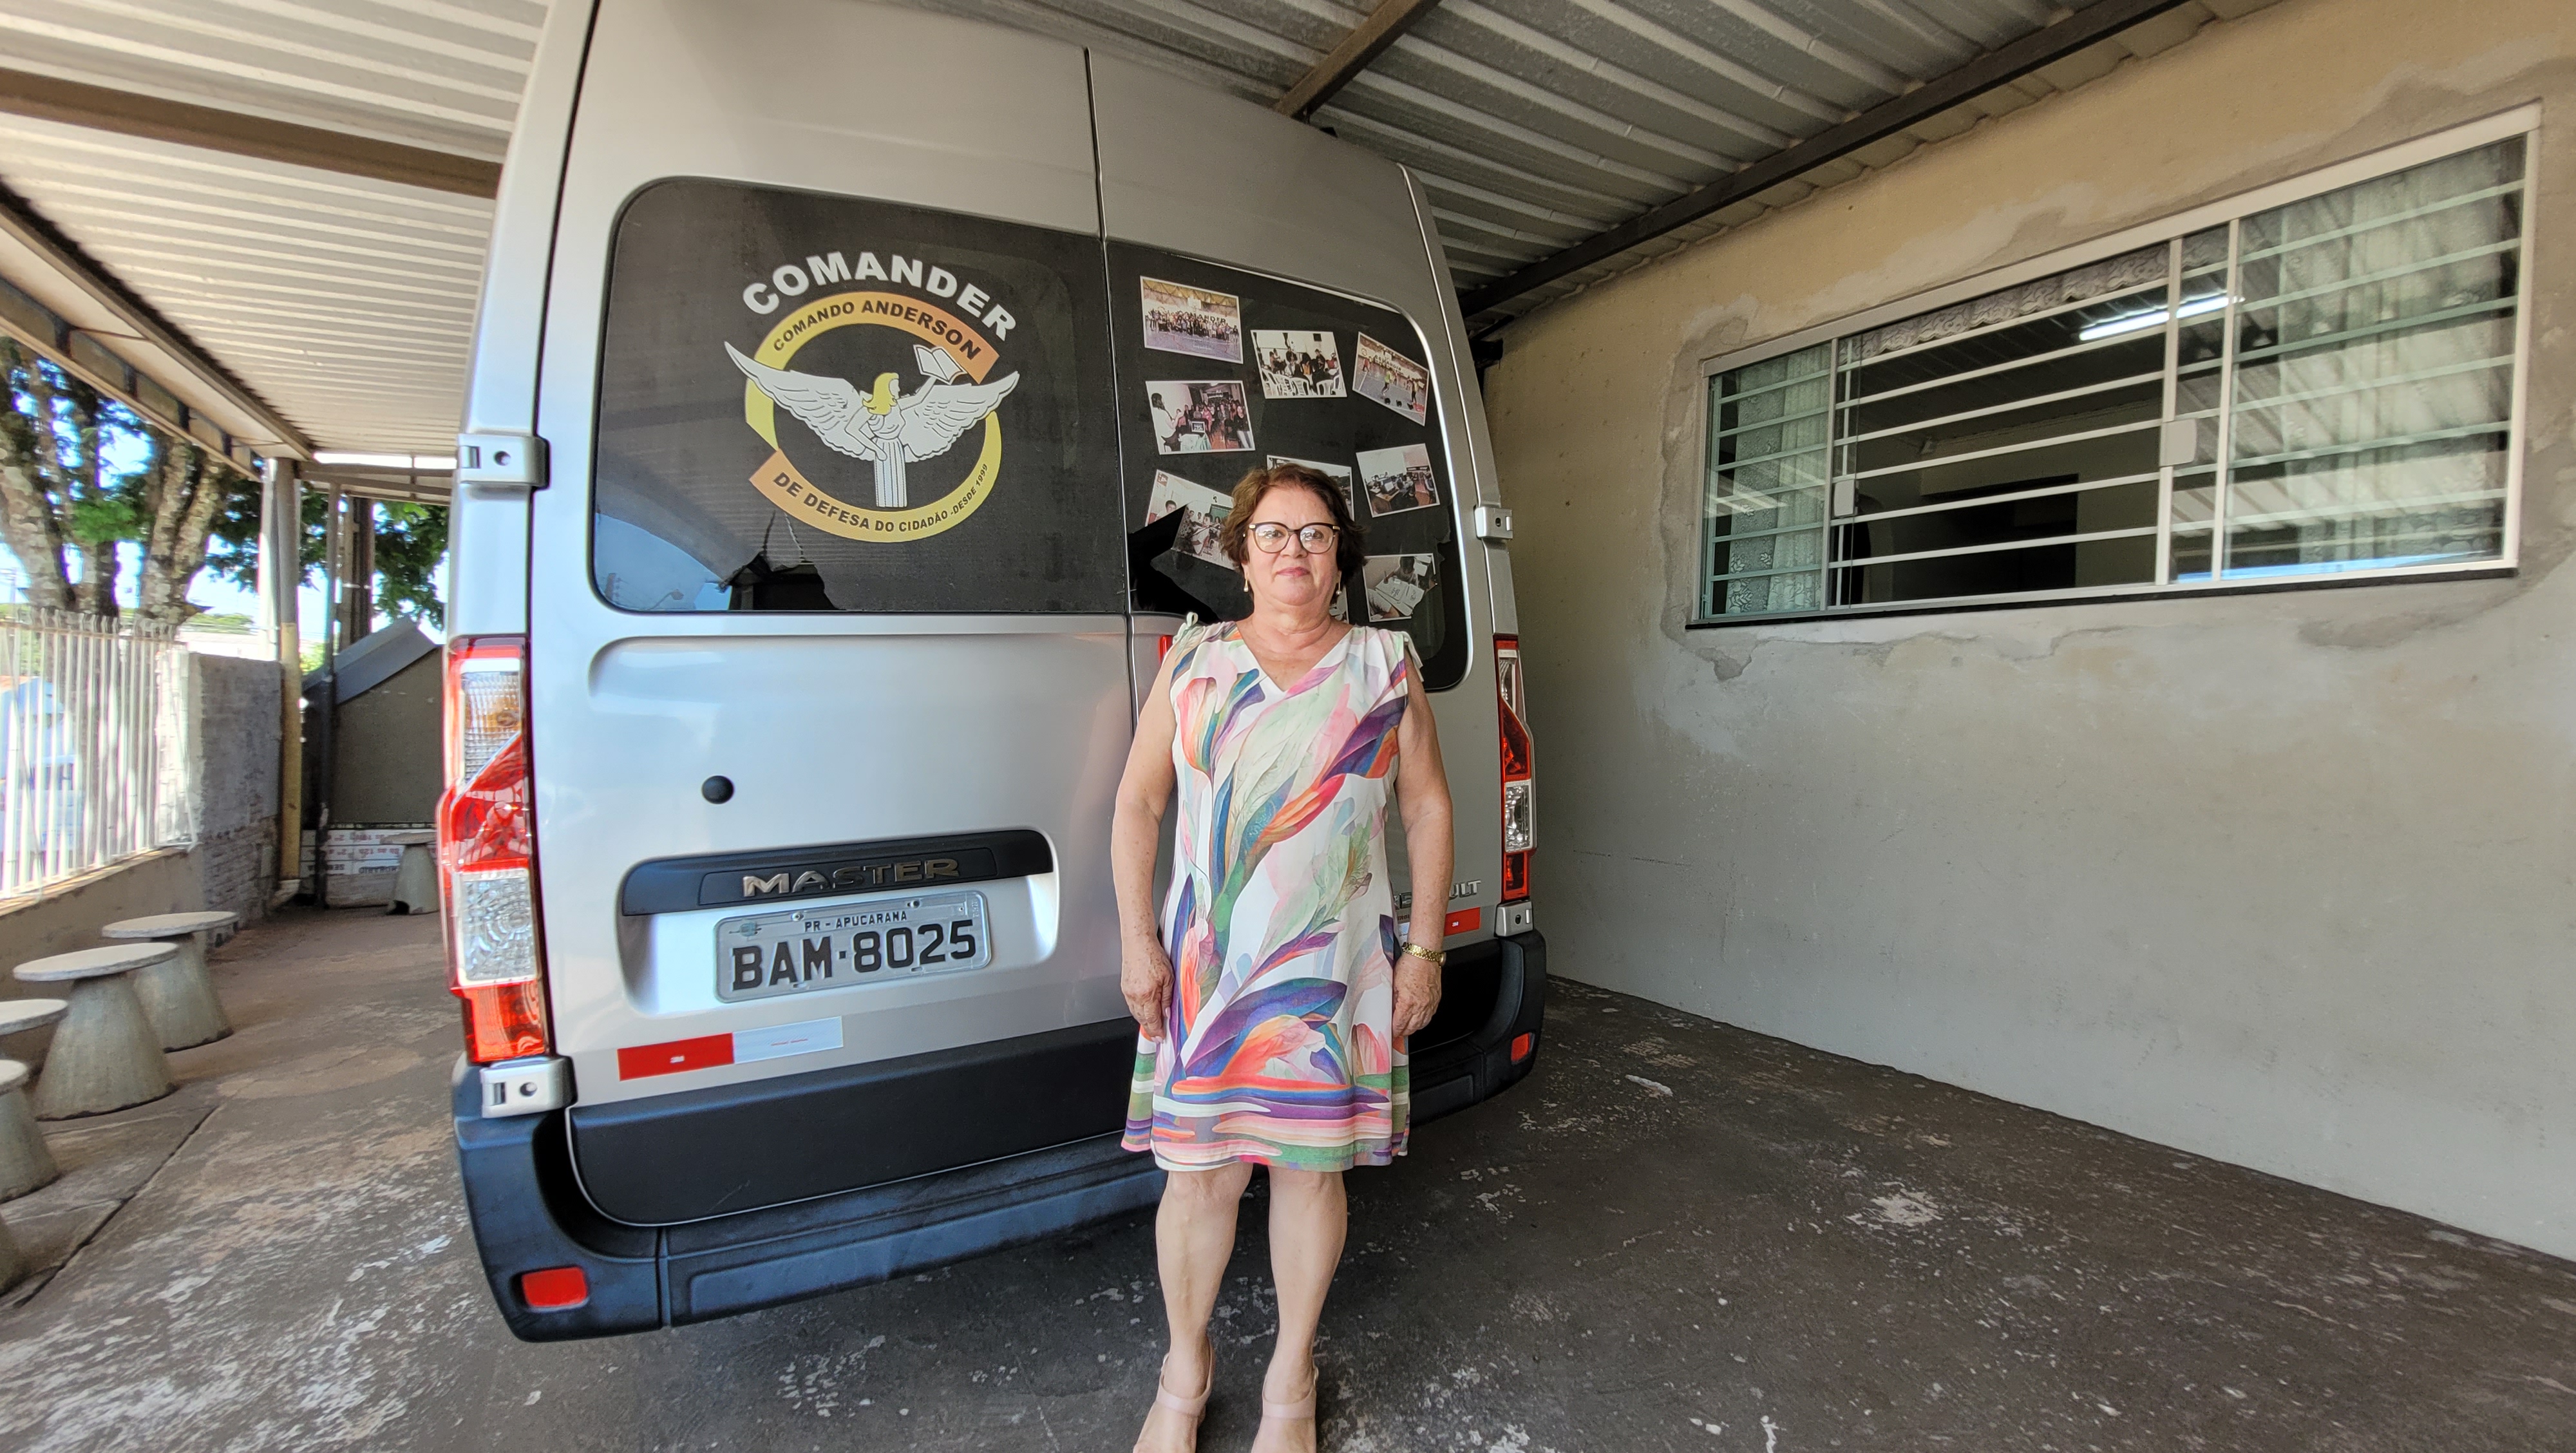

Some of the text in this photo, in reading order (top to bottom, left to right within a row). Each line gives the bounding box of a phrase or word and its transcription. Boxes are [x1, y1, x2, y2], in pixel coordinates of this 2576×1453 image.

[743, 252, 1016, 341] COMANDER
[773, 299, 981, 360] COMANDO ANDERSON
[773, 471, 804, 498] DE
[803, 493, 869, 529] DEFESA
[875, 520, 895, 532] DO
[898, 510, 948, 532] CIDADÃO
[975, 463, 988, 486] 1999
[743, 859, 960, 897] MASTER
[804, 920, 820, 932] PR
[836, 911, 907, 928] APUCARANA
